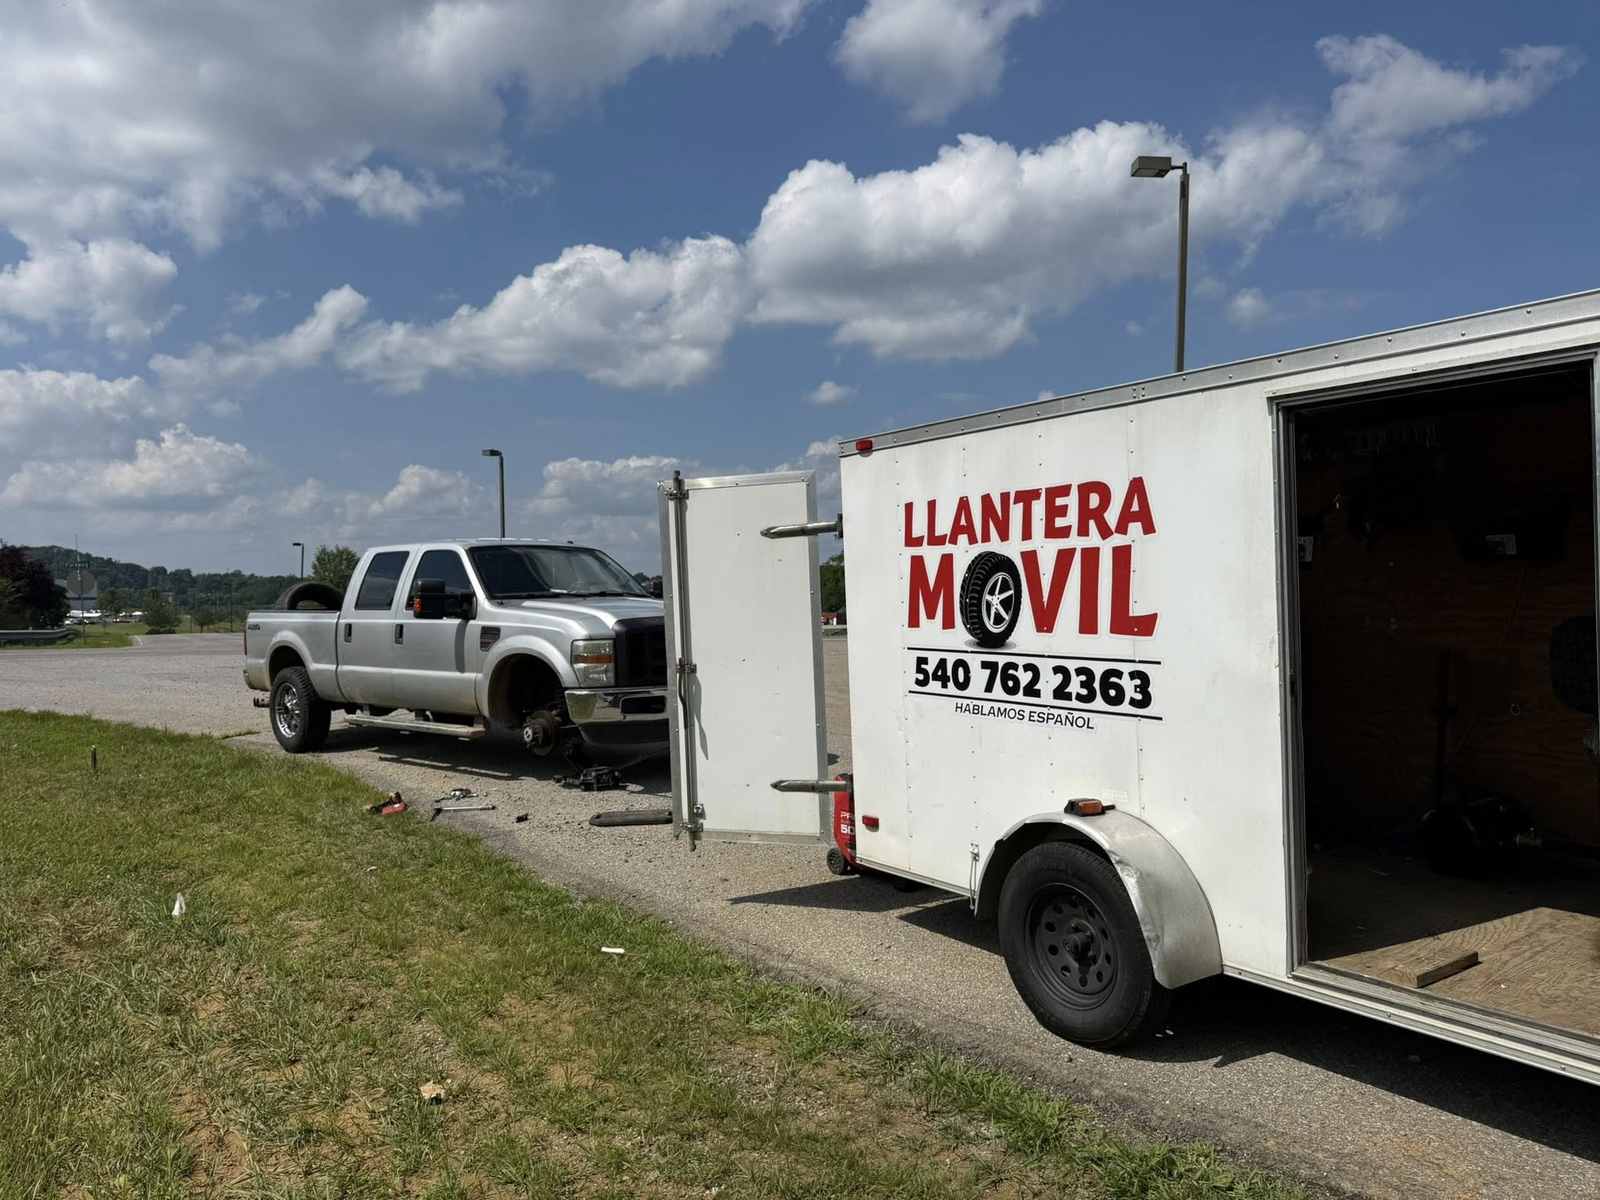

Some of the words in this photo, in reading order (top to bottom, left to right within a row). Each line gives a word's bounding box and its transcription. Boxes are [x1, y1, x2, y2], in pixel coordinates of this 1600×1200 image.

[904, 476, 1156, 547] LLANTERA
[914, 656, 971, 691] 540
[980, 660, 1041, 698] 762
[1052, 665, 1152, 709] 2363
[955, 702, 1025, 721] HABLAMOS
[1028, 711, 1095, 729] ESPAÑOL
